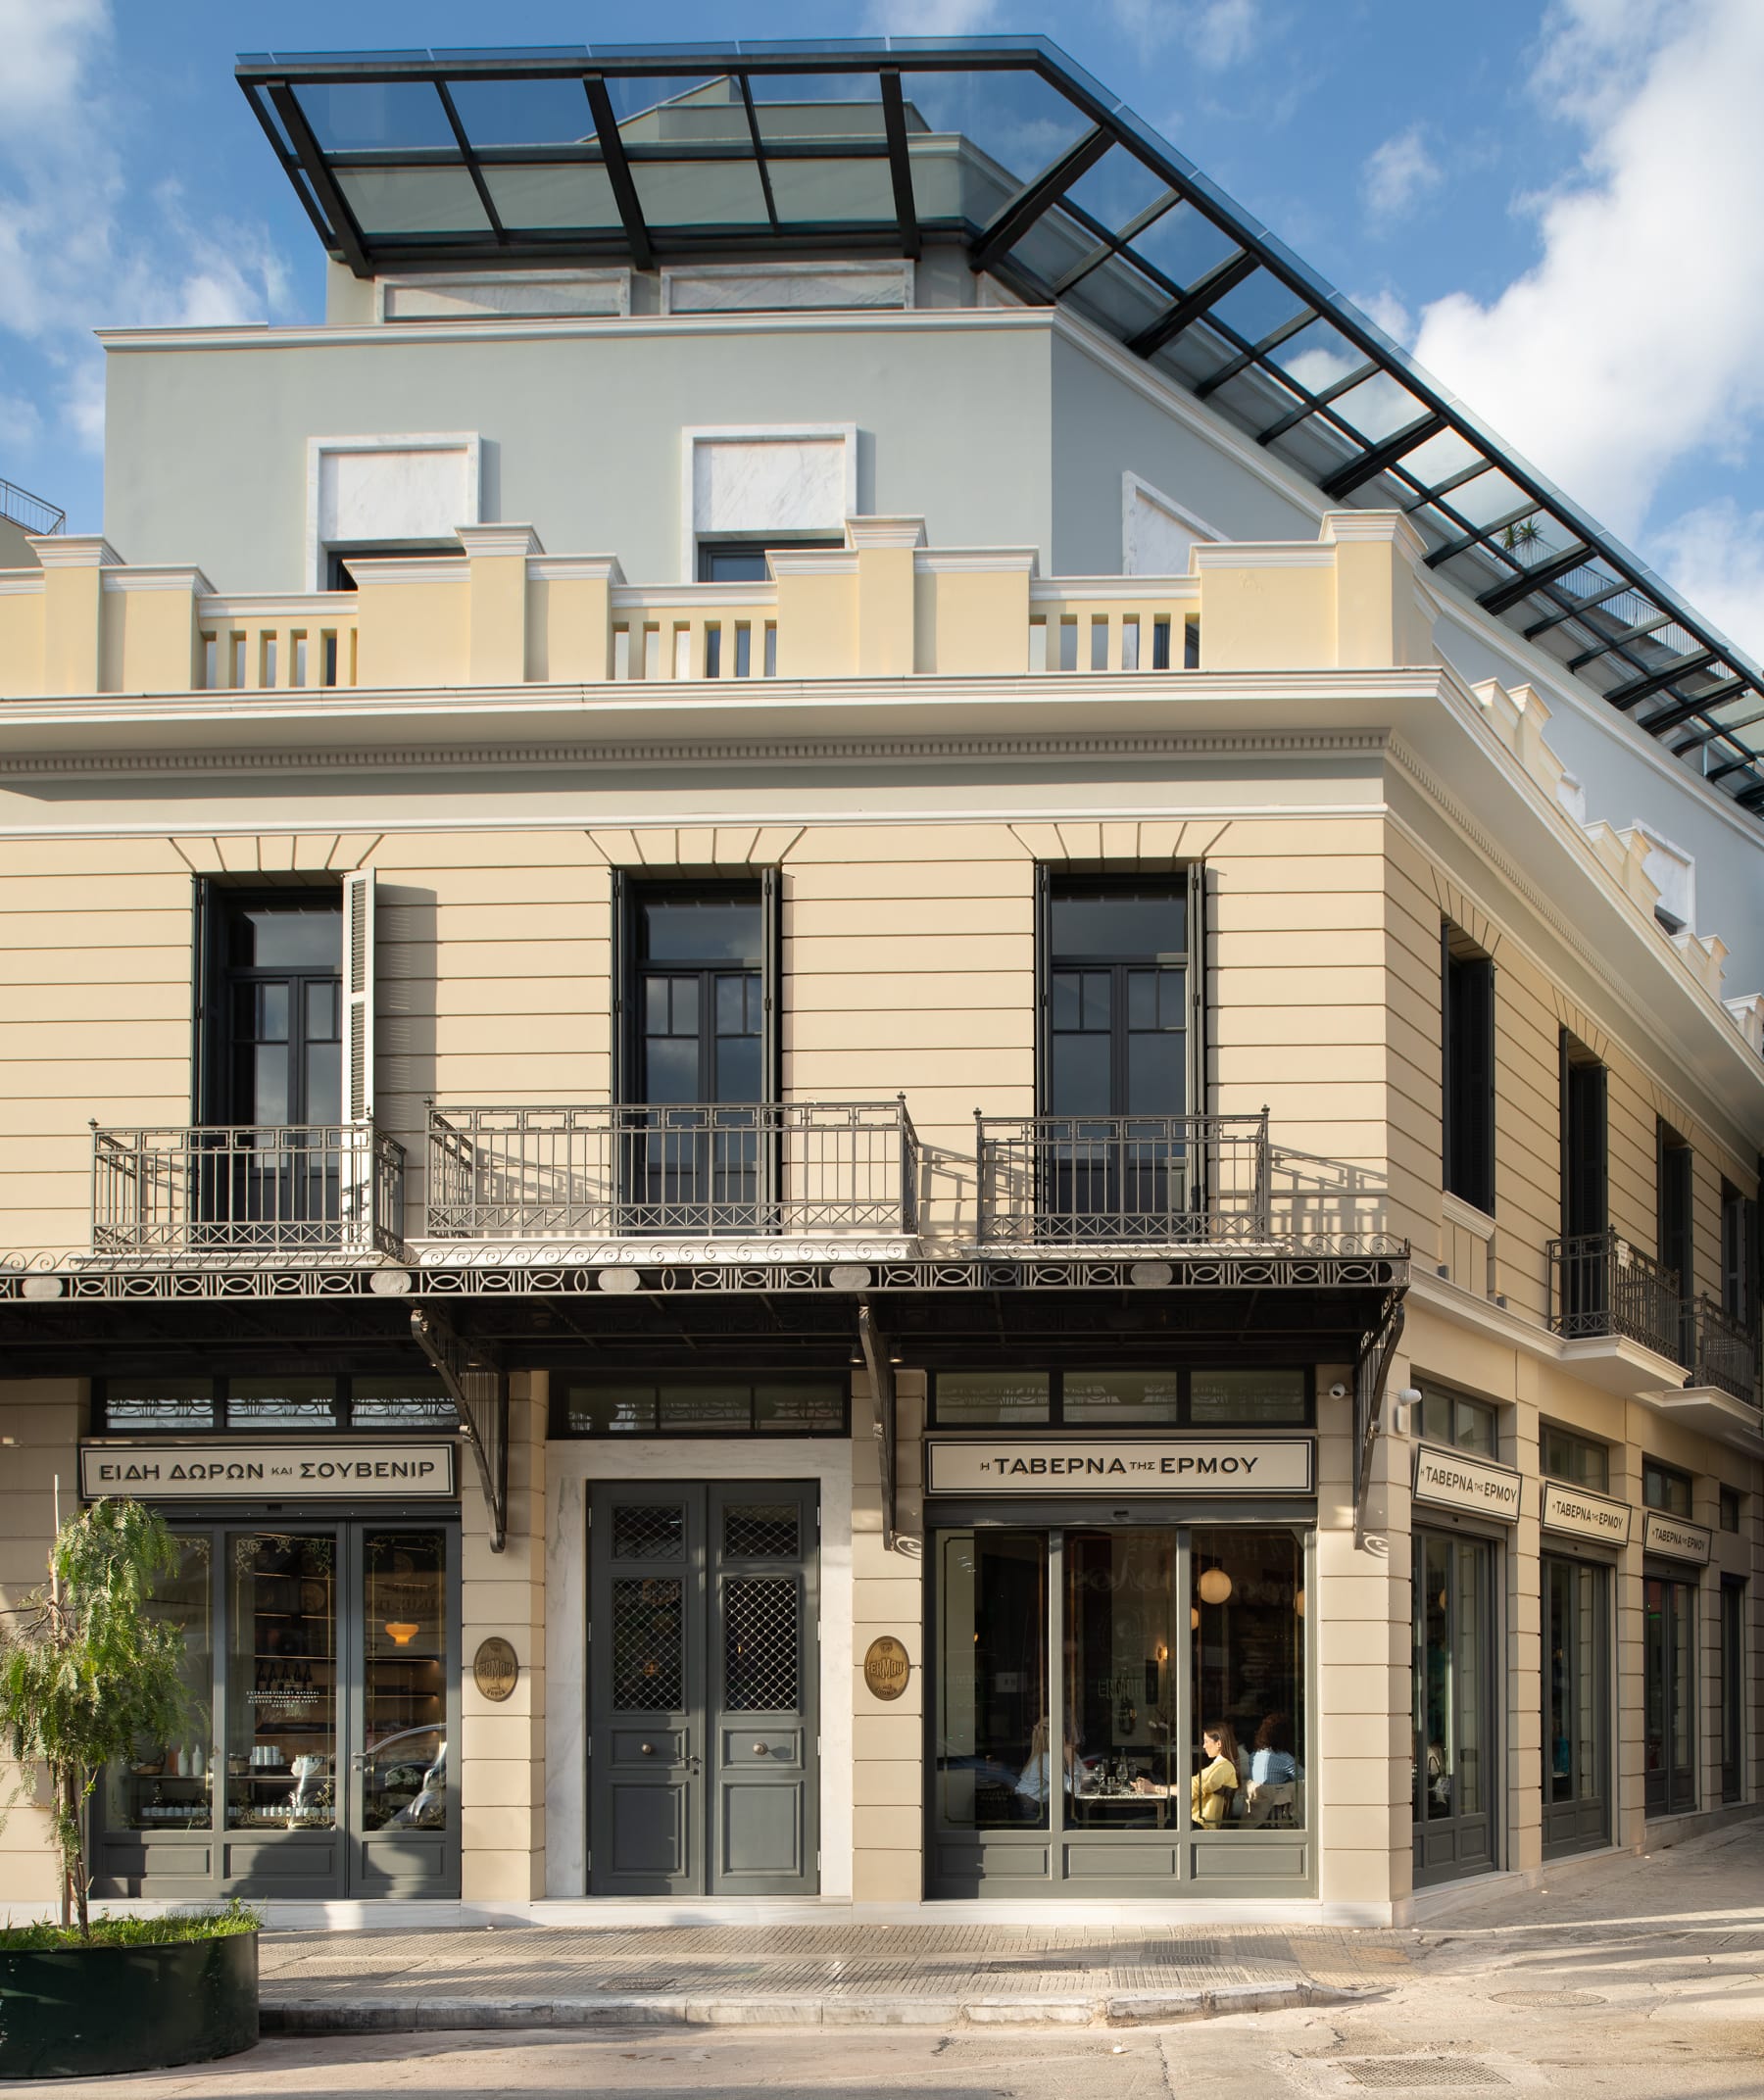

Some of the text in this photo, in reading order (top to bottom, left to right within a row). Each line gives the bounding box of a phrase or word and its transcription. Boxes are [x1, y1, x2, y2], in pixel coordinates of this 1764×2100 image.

[100, 1461, 435, 1481] ΕΙΔΗ ΔΩΡΩΝ ΚΑΙ ΣΟΥΒΕΝΙΡ
[993, 1457, 1127, 1475] ΤΑΒΕΡΝΑ
[1129, 1461, 1156, 1471] ΤΗΣ
[1159, 1456, 1259, 1475] ΕΡΜΟΥ
[1425, 1465, 1474, 1493] ΤΑΒΕΡΝΑ
[1484, 1482, 1517, 1504] ΕΡΜΟΥ
[1556, 1500, 1592, 1523] ΤΑΒΕΡΝΑ
[1598, 1512, 1624, 1530] ΕΡΜΟΥ
[870, 1658, 904, 1679] ERMOU
